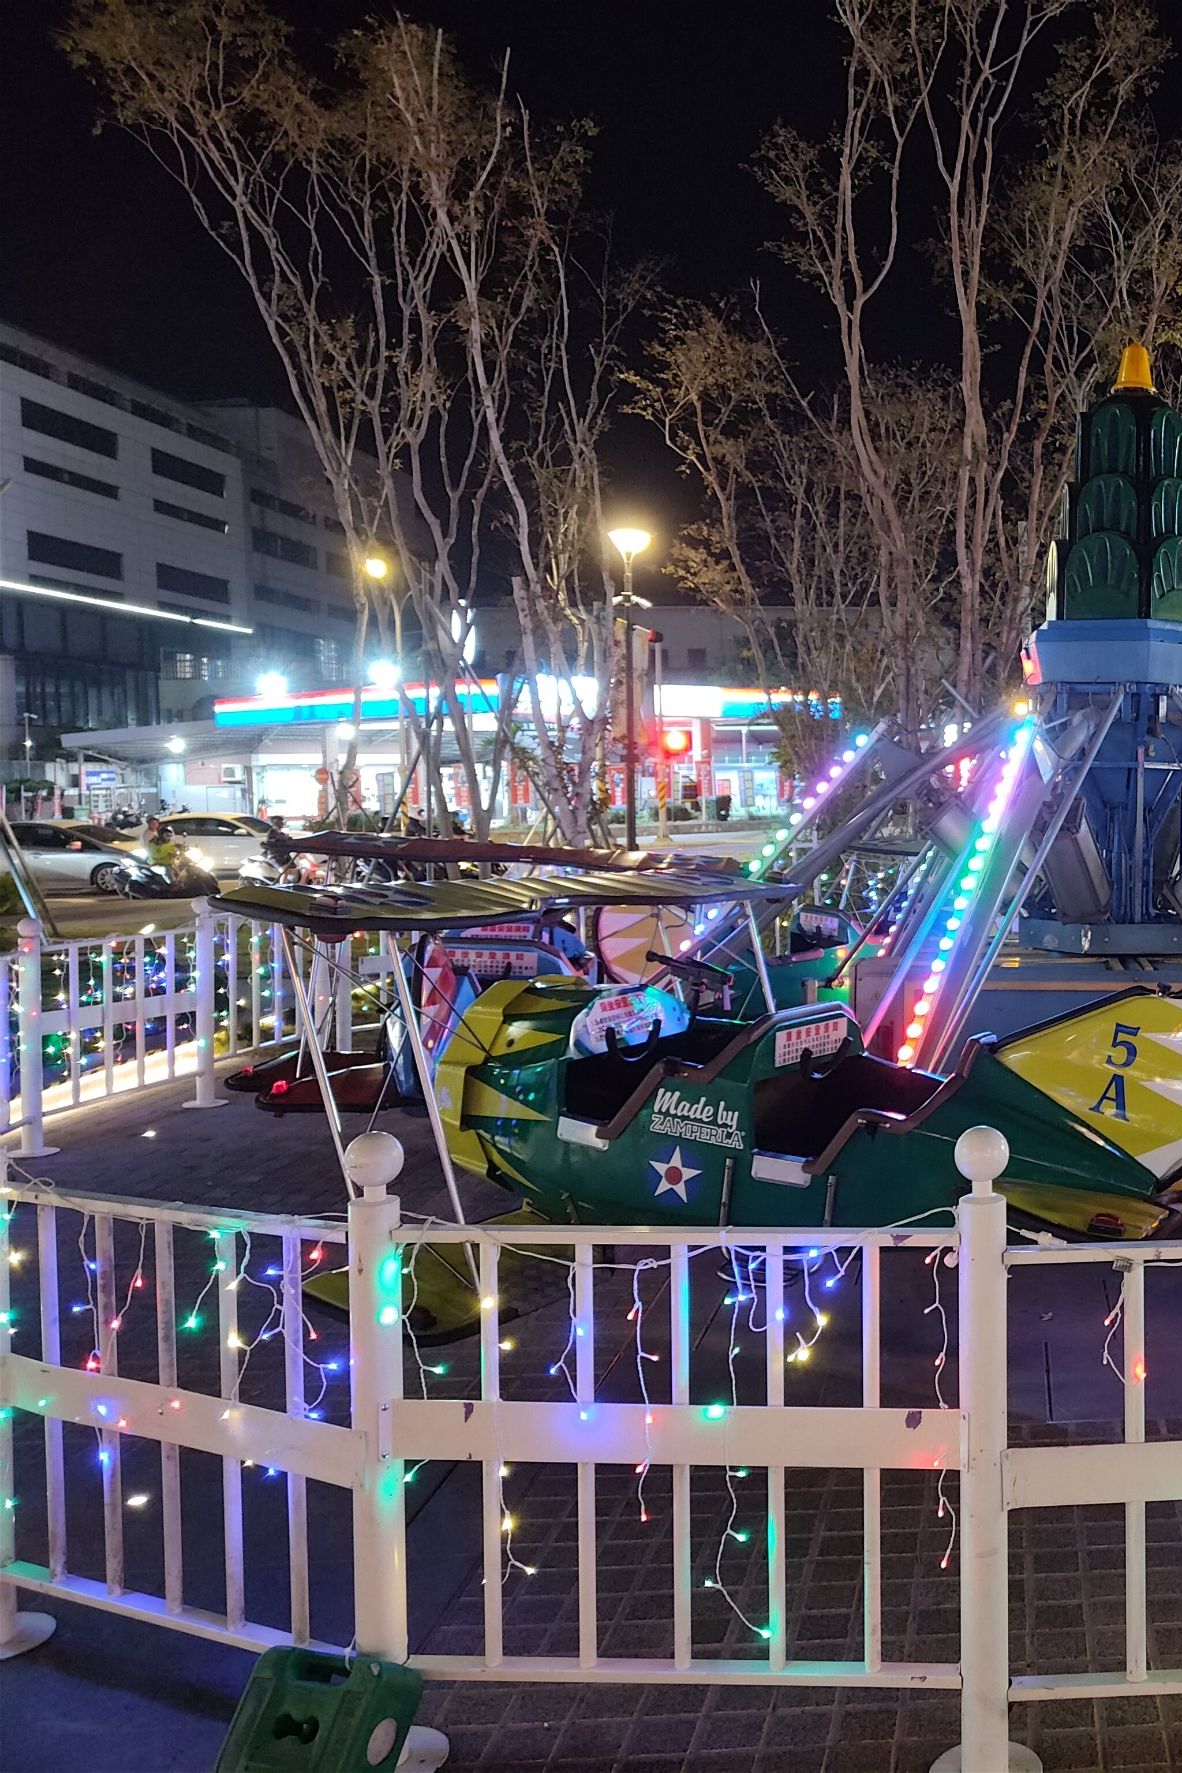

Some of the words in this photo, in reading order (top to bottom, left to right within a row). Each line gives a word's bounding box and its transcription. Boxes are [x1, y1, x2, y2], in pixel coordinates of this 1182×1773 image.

[1105, 1022, 1141, 1069] 5
[653, 1087, 714, 1122] Made
[717, 1100, 739, 1133] by
[1088, 1073, 1130, 1122] A
[650, 1113, 744, 1149] ZAMPERLA
